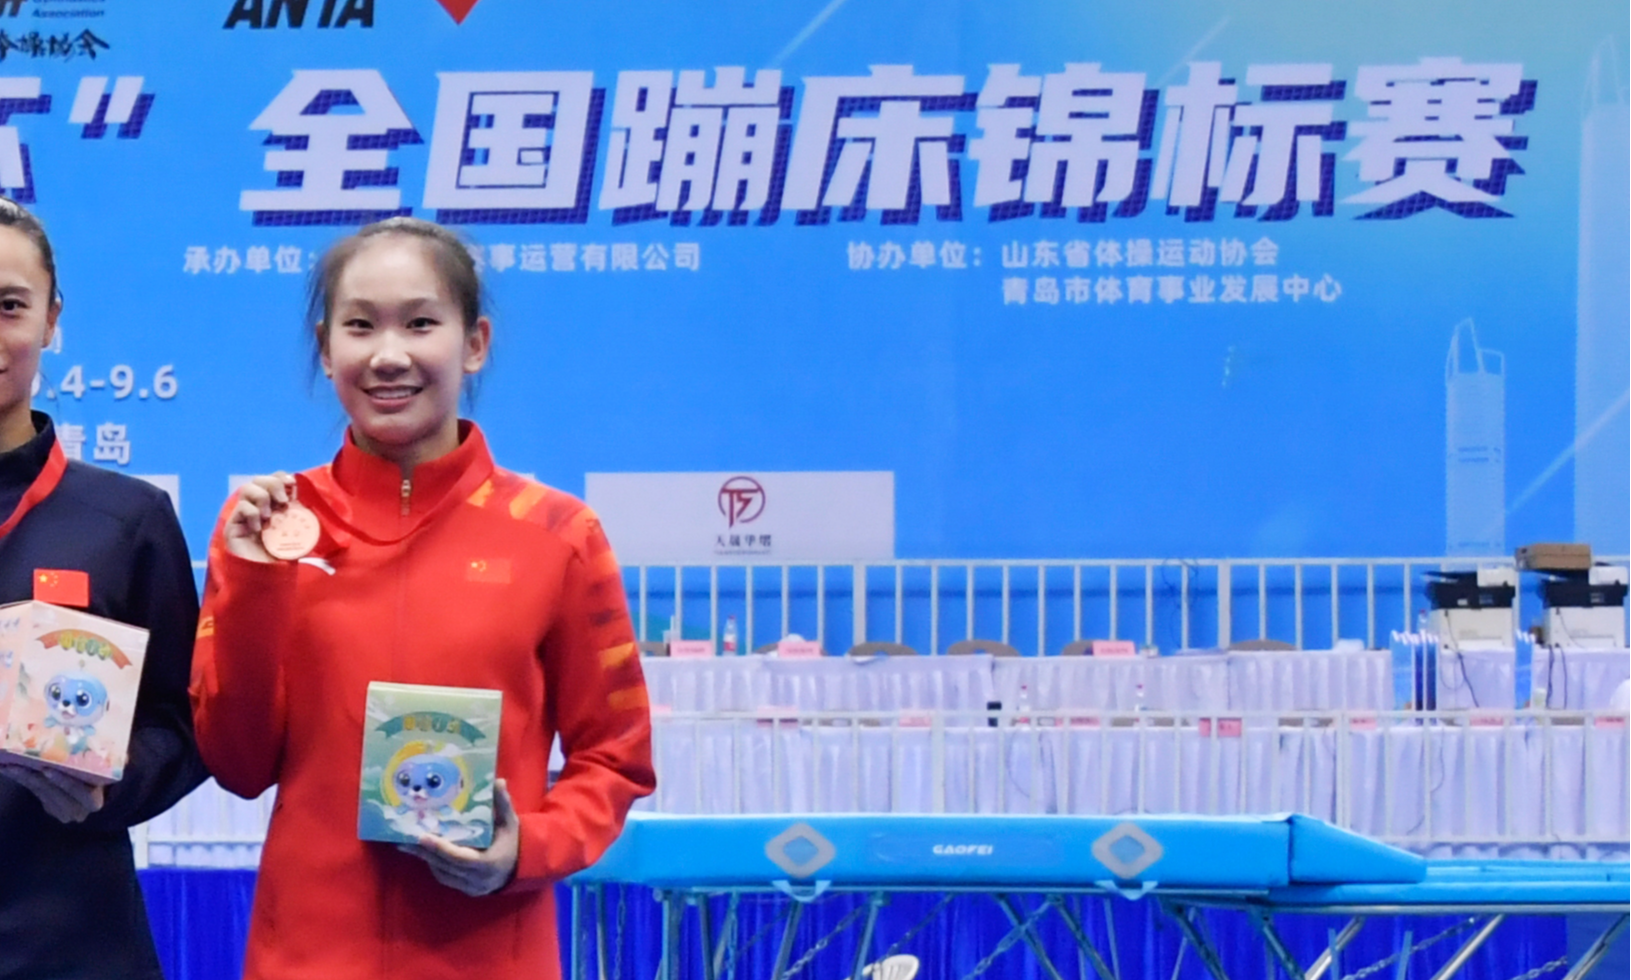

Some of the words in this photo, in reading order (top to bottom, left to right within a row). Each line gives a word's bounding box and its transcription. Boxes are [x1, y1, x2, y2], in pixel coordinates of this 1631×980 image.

[238, 57, 1538, 227] 全国蹦床锦标赛
[1001, 274, 1343, 306] 青岛市体育事业发展中心
[932, 844, 993, 855] GAOFEI
